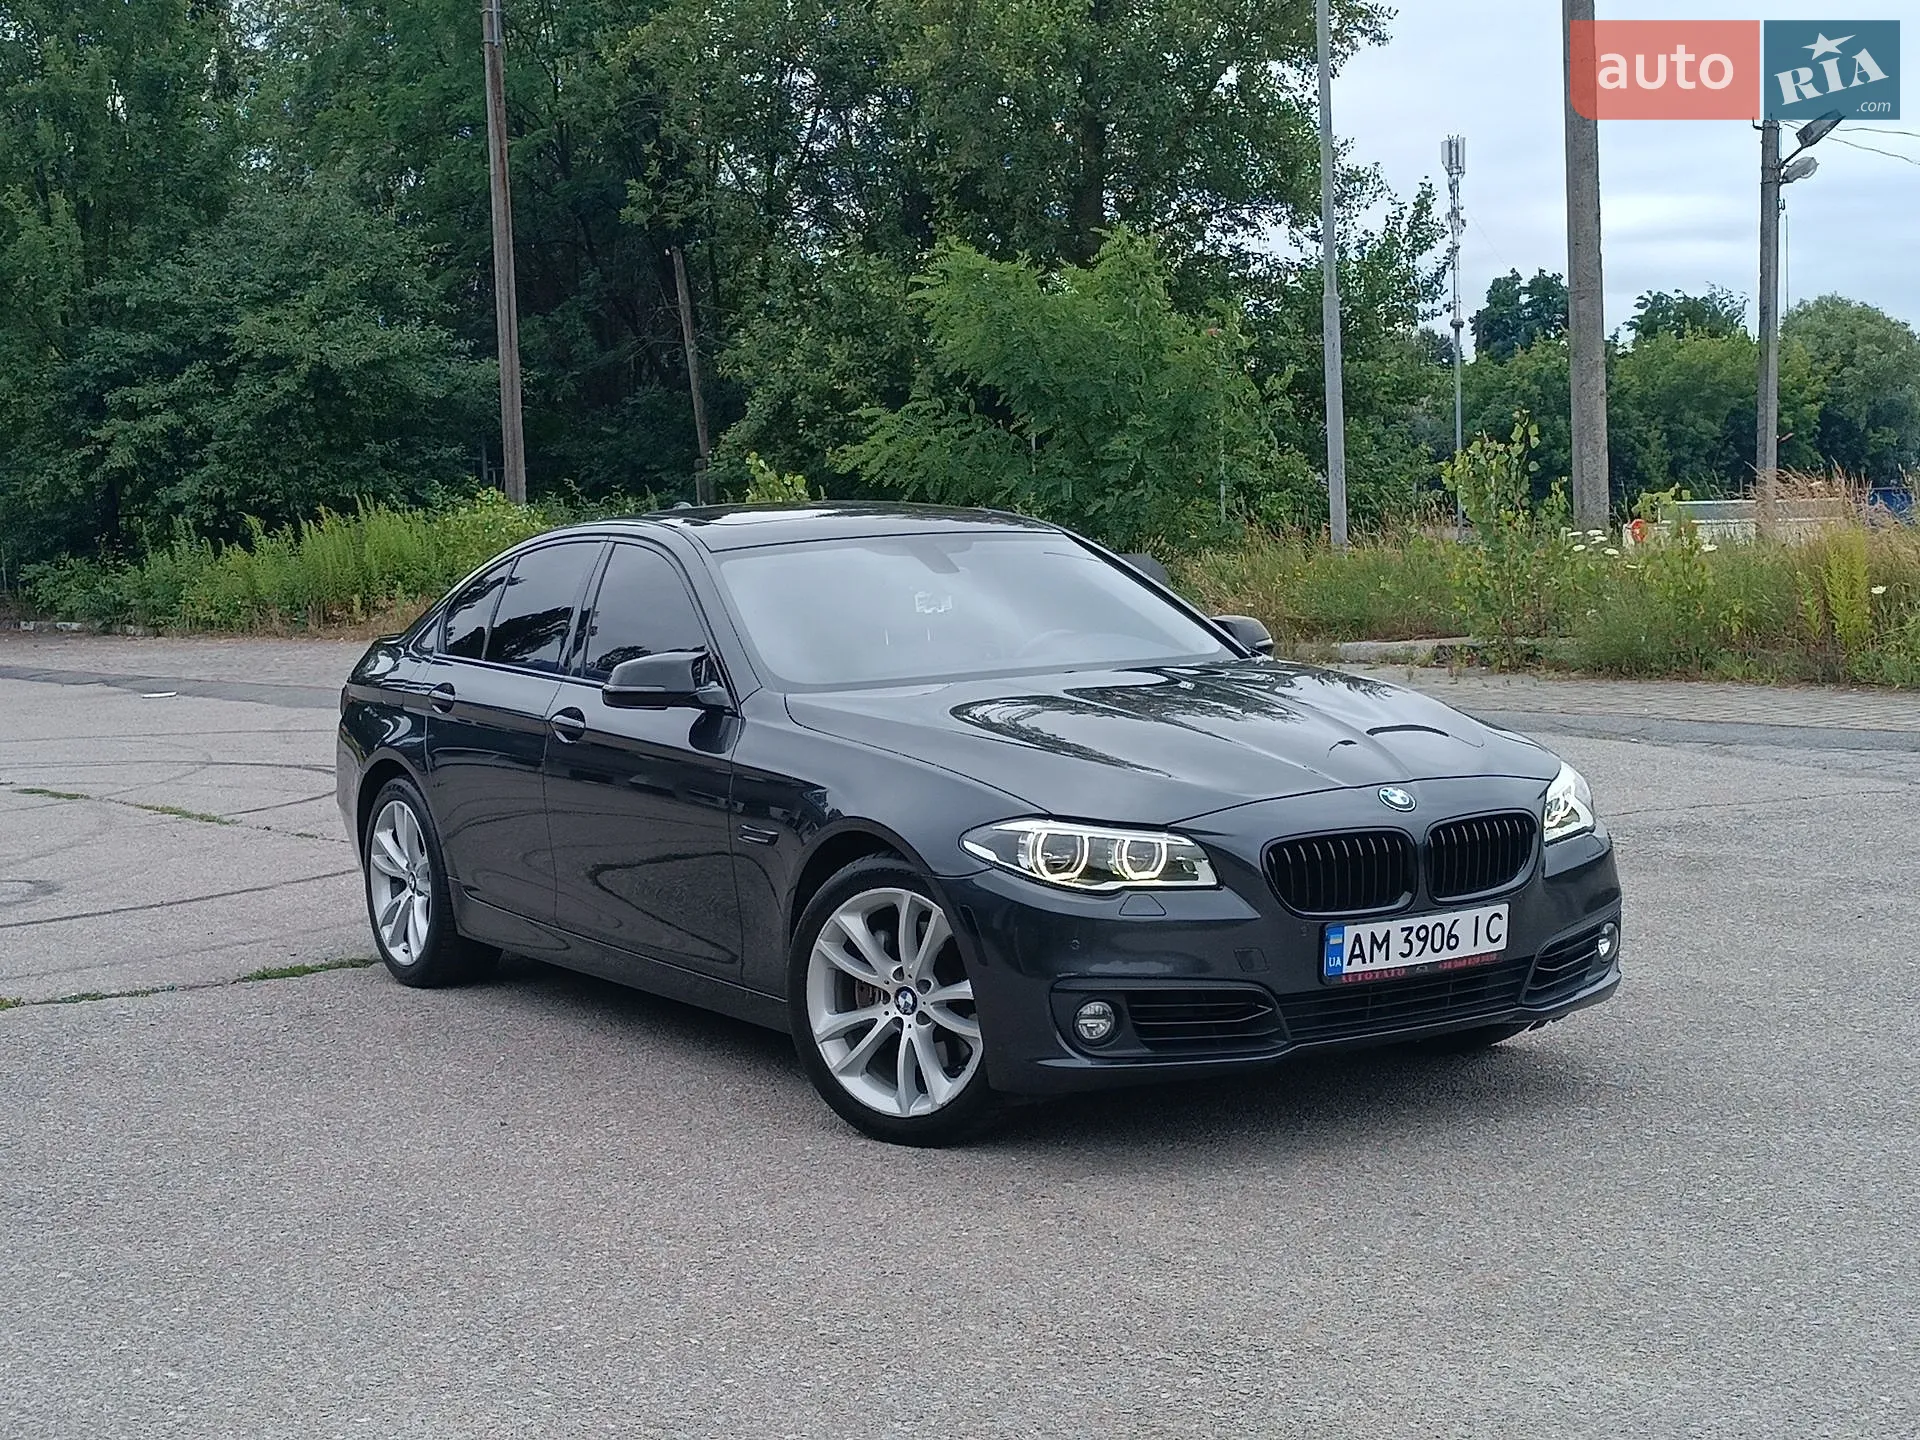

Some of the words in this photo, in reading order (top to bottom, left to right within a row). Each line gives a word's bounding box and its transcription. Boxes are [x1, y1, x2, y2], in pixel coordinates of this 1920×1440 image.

[1347, 929, 1391, 966] AM
[1399, 918, 1461, 959] 3906
[1473, 912, 1504, 947] IC
[1328, 955, 1342, 967] UA
